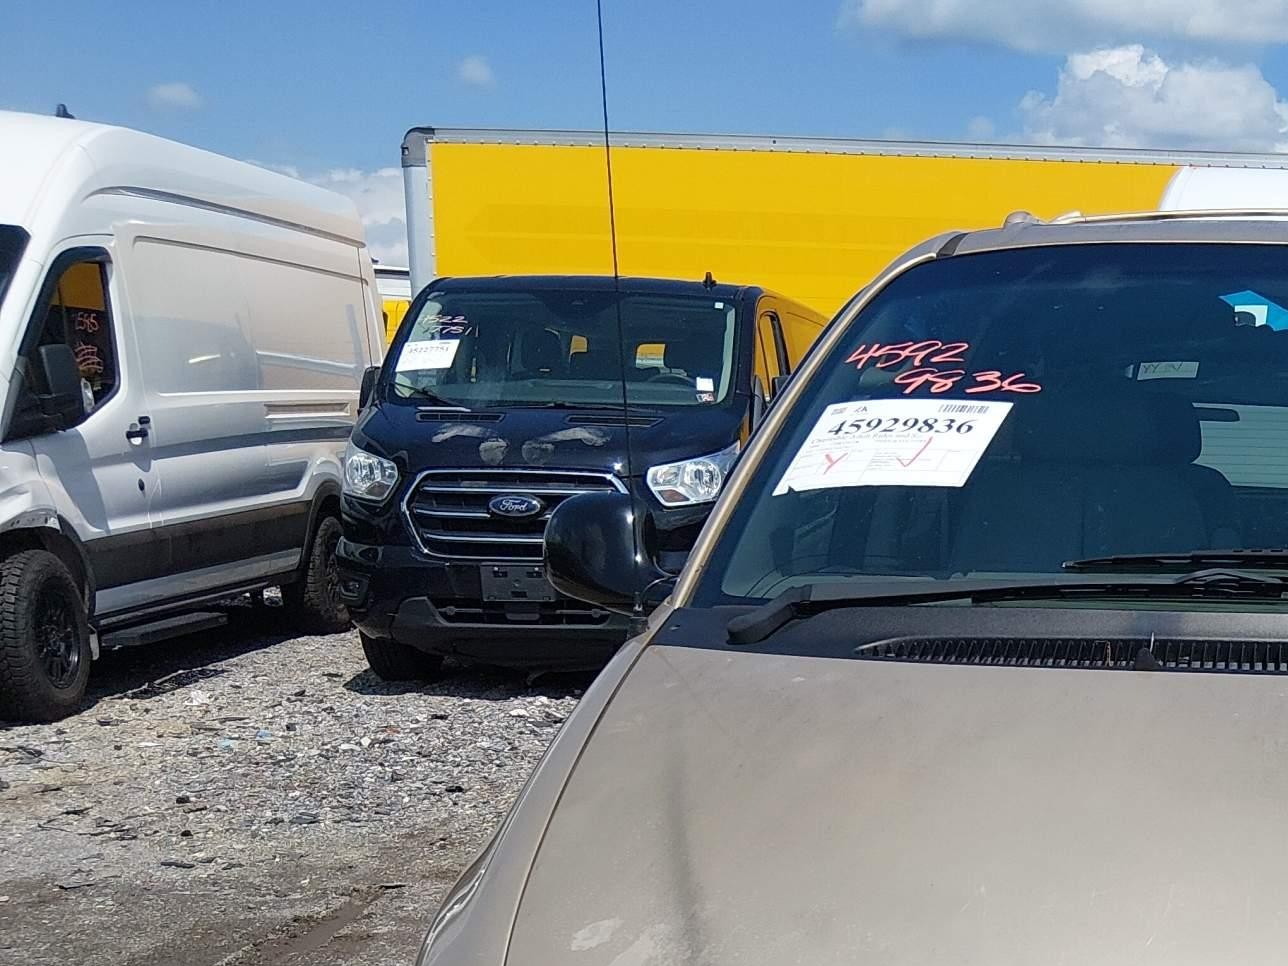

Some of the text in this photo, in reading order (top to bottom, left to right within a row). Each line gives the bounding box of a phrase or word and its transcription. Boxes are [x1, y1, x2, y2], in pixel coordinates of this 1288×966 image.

[845, 341, 969, 369] 4592
[827, 417, 978, 435] 45929836
[500, 499, 528, 511] Ford
